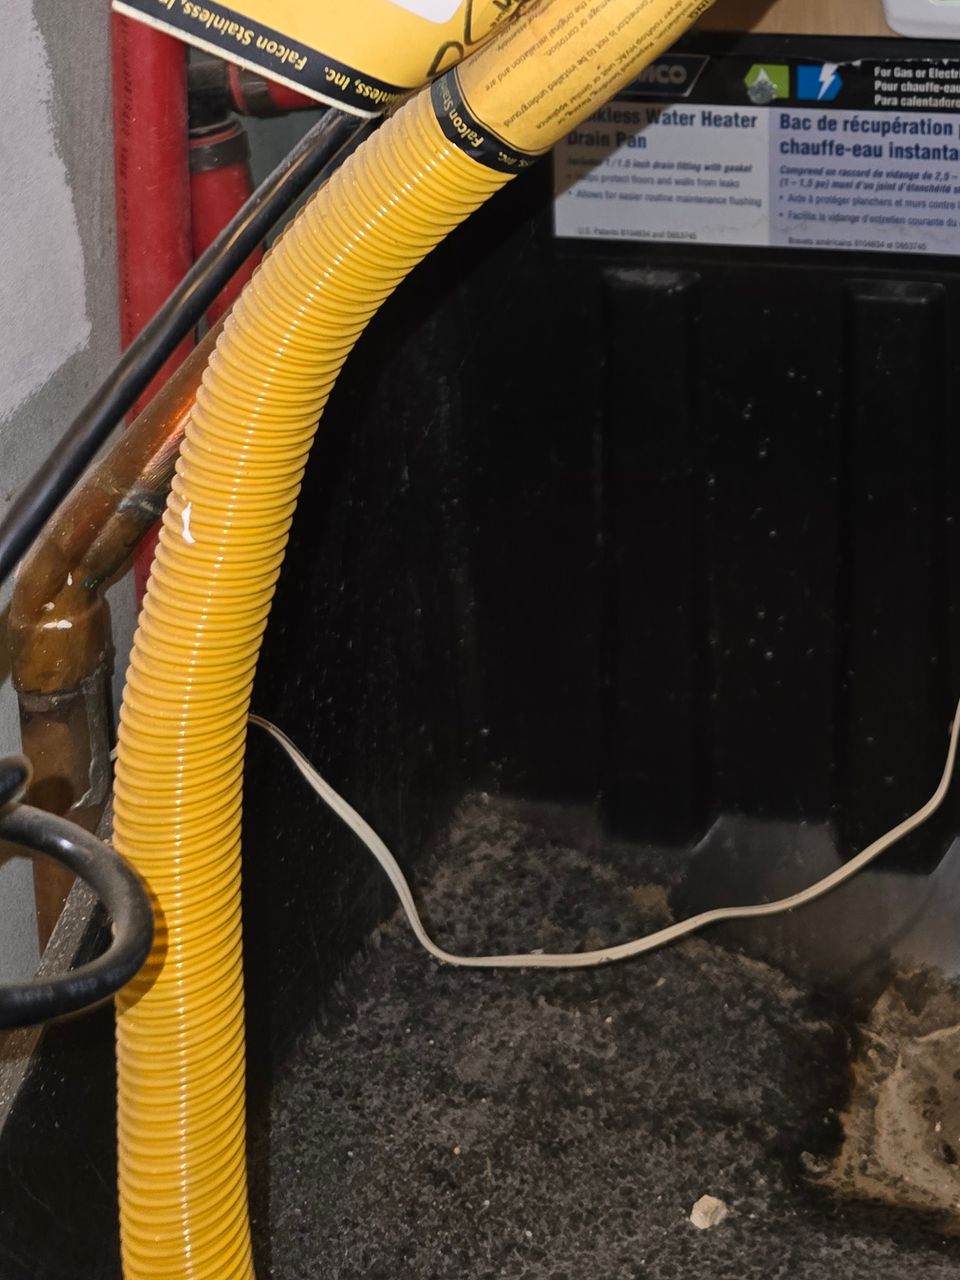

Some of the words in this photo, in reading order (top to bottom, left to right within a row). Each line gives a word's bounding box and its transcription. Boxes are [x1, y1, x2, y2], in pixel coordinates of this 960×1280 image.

[256, 36, 308, 71] Falcon
[324, 66, 350, 86] Inc.
[874, 67, 891, 77] For
[894, 67, 913, 77] Gas
[915, 69, 926, 77] or
[874, 80, 898, 91] Pour
[874, 94, 898, 106] Para
[449, 108, 484, 148] Falcon
[646, 108, 695, 126] Water
[702, 111, 757, 128] Heater
[780, 113, 811, 130] Bac
[818, 115, 837, 131] de
[843, 115, 952, 137] récupération
[567, 131, 610, 147] Drain
[616, 133, 647, 148] Pan
[780, 138, 883, 158] chauffe-eau
